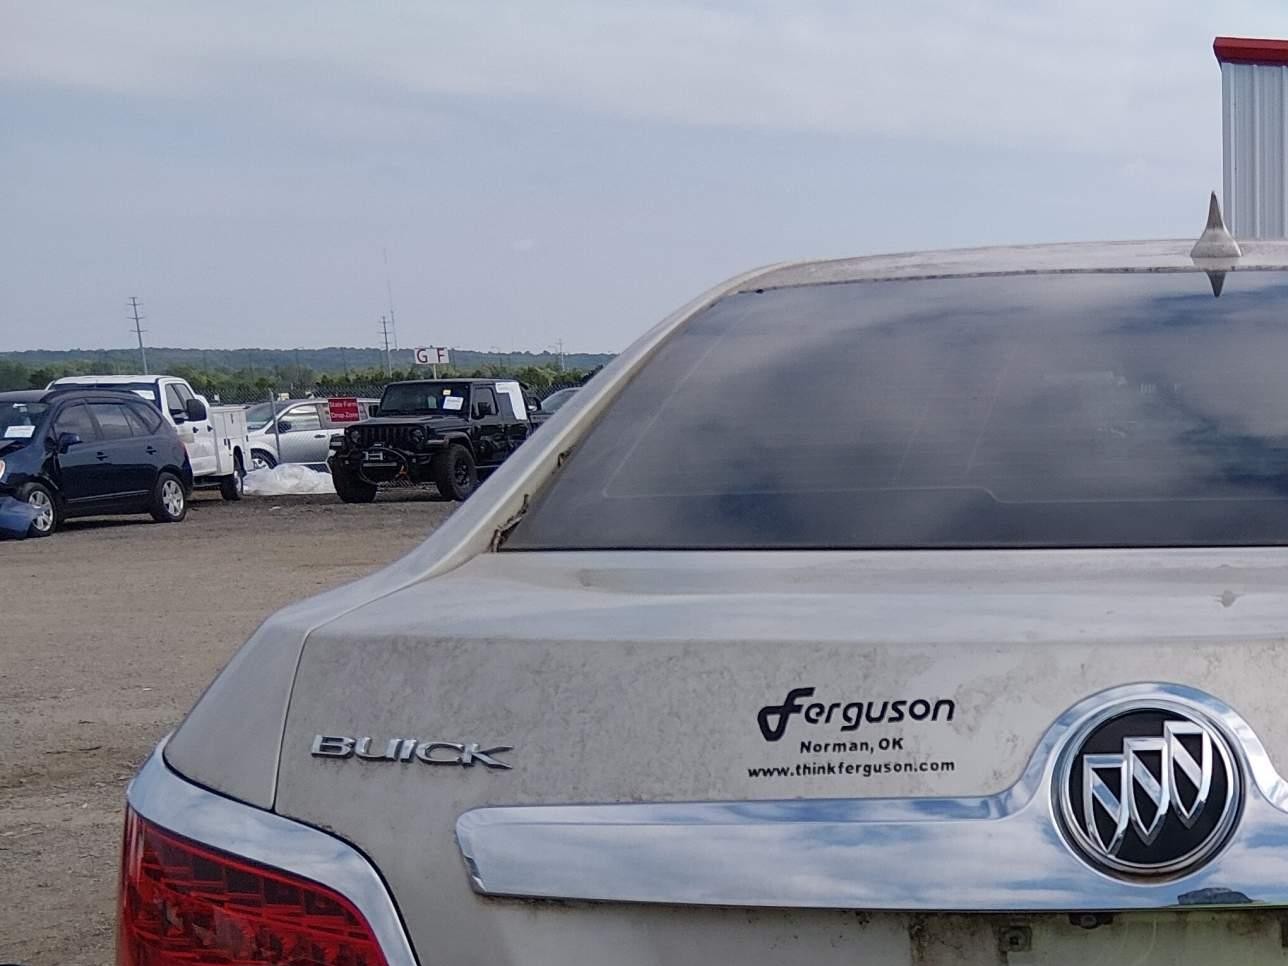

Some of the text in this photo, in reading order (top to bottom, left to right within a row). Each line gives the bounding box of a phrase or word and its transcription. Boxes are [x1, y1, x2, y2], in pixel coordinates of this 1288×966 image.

[416, 347, 445, 363] G F
[757, 687, 956, 742] Ferguson
[311, 734, 514, 770] BUICK
[800, 737, 904, 755] Norman, OK
[748, 760, 956, 778] www.thinkferguson.com
